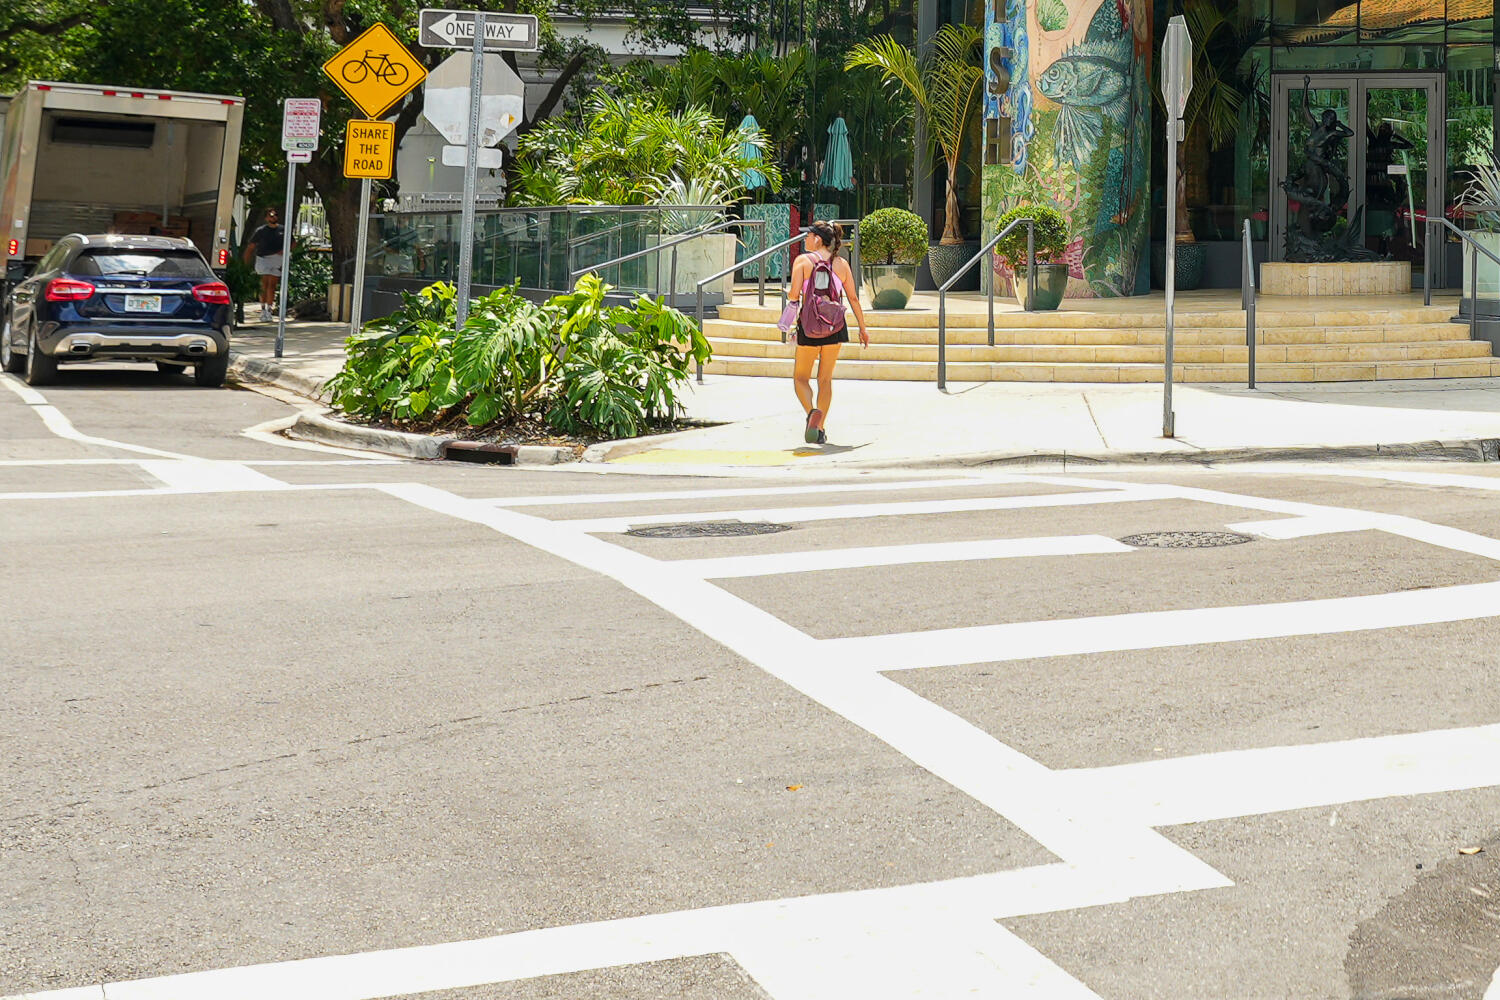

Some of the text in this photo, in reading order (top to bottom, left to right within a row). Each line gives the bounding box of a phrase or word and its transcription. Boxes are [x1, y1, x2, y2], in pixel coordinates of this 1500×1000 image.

[445, 22, 515, 39] ONE WAY
[352, 128, 389, 140] SHARE
[359, 143, 380, 155] THE
[353, 158, 383, 171] ROAD
